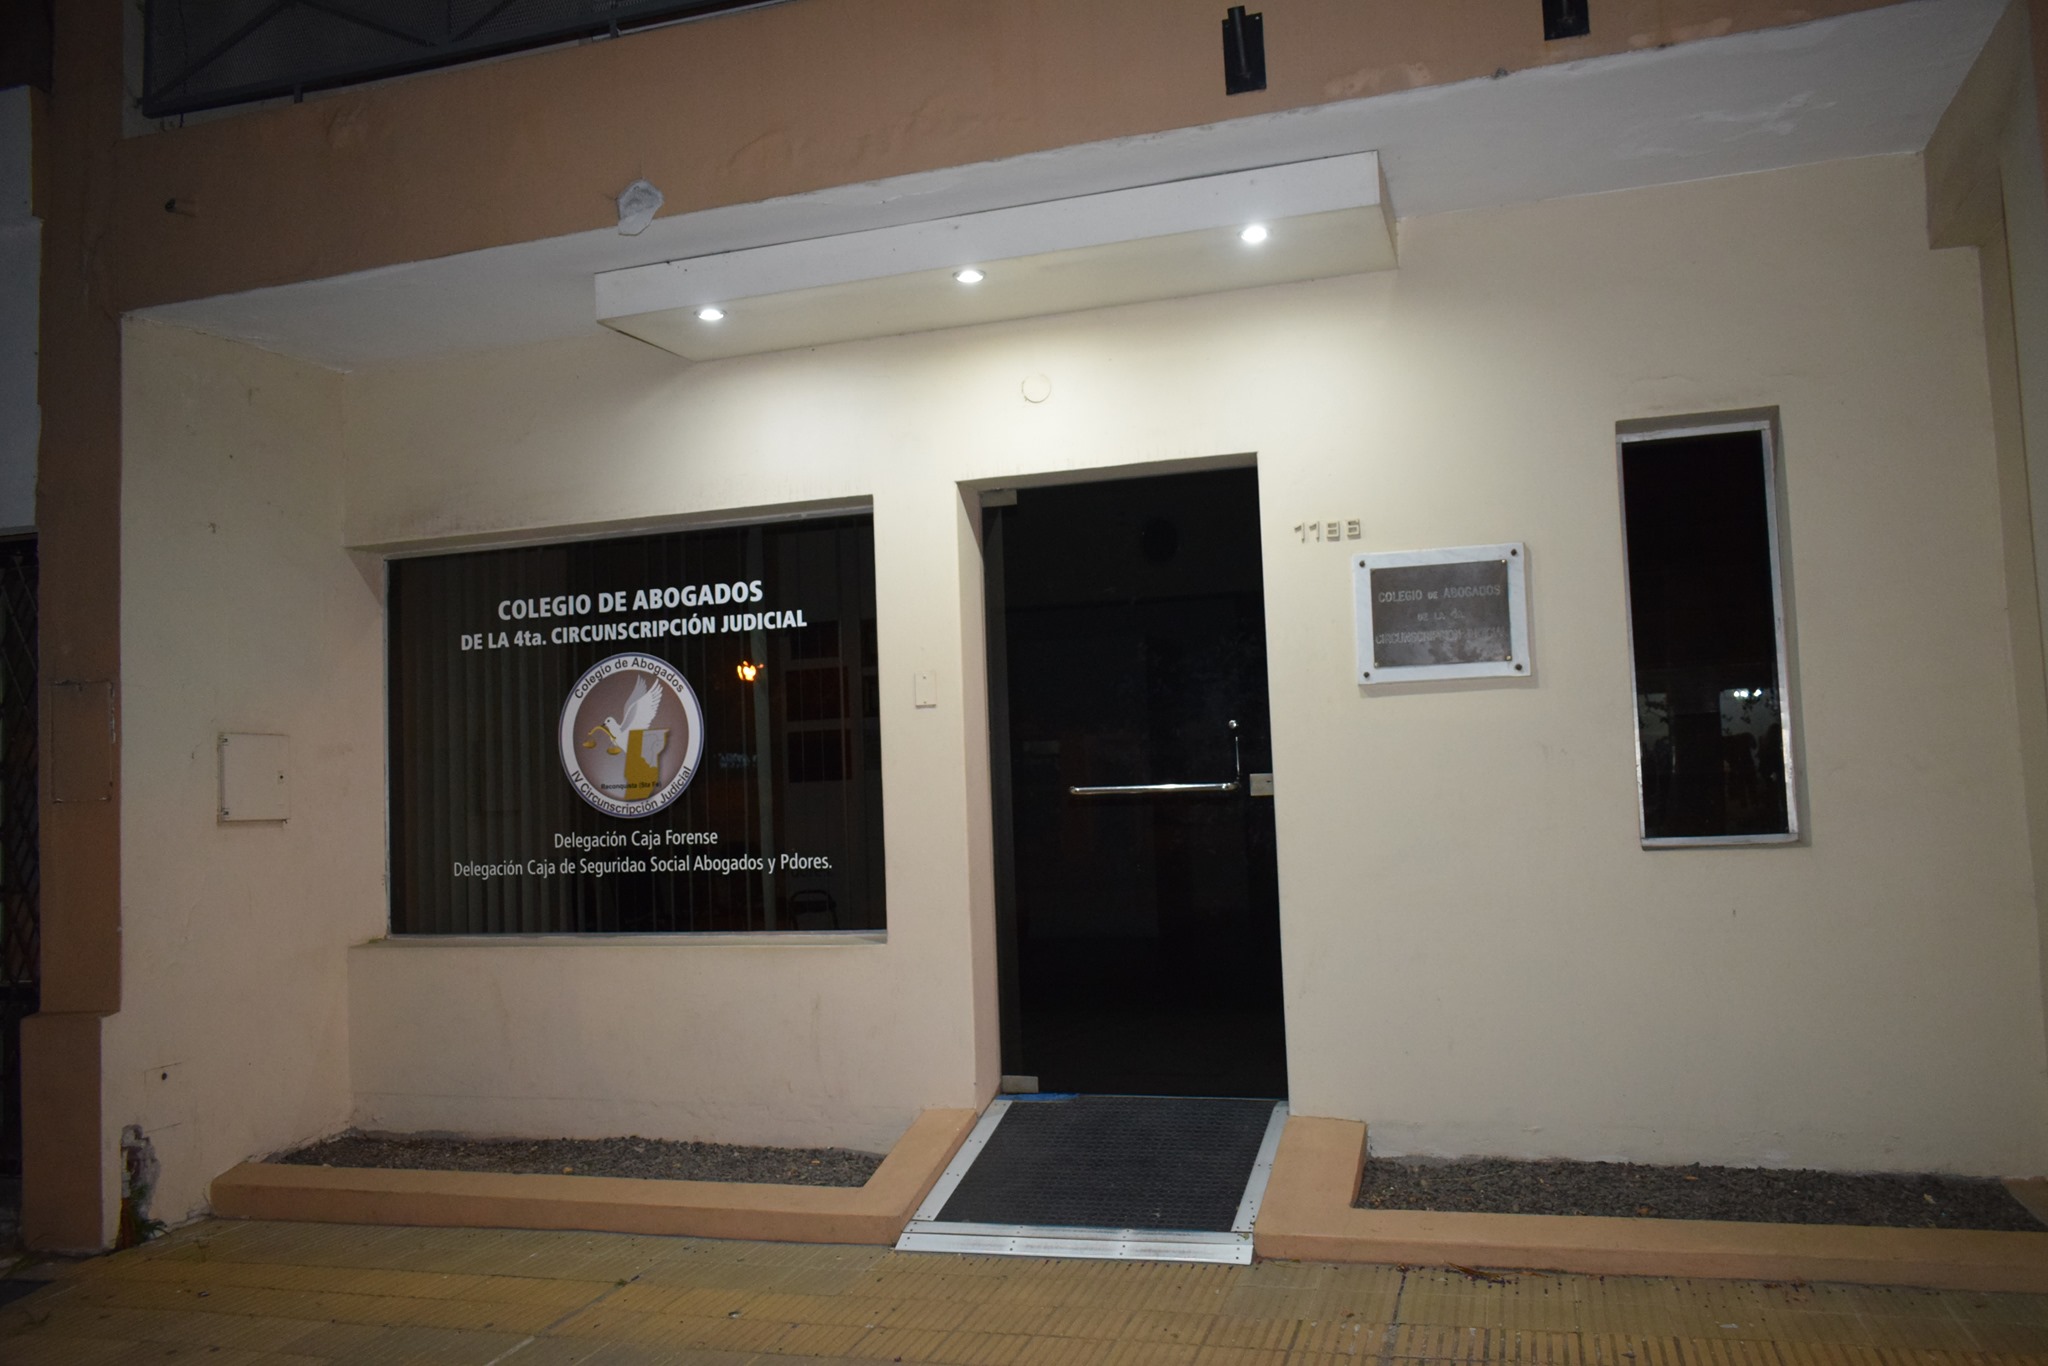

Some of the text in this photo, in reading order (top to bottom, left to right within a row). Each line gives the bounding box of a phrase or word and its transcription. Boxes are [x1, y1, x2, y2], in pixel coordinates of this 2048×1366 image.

[498, 579, 764, 621] COLEGIO DE ABOGADOS
[1378, 590, 1423, 603] COLEGIO
[1443, 585, 1501, 599] ABOGADOS
[461, 609, 808, 650] DE LA 4ta. CIRCUNSCRIPCIÓN JUDICIAL
[574, 657, 685, 699] Colegio de Abogados
[571, 765, 692, 816] IV Circunscripción Judicial
[554, 829, 719, 852] Delegación Caja Forense
[453, 859, 523, 881] Delegación
[527, 859, 556, 879] Caja
[559, 858, 576, 874] de
[650, 854, 691, 873] Social
[692, 854, 764, 876] Abogados
[767, 857, 776, 875] y
[780, 852, 833, 870] Pdores.
